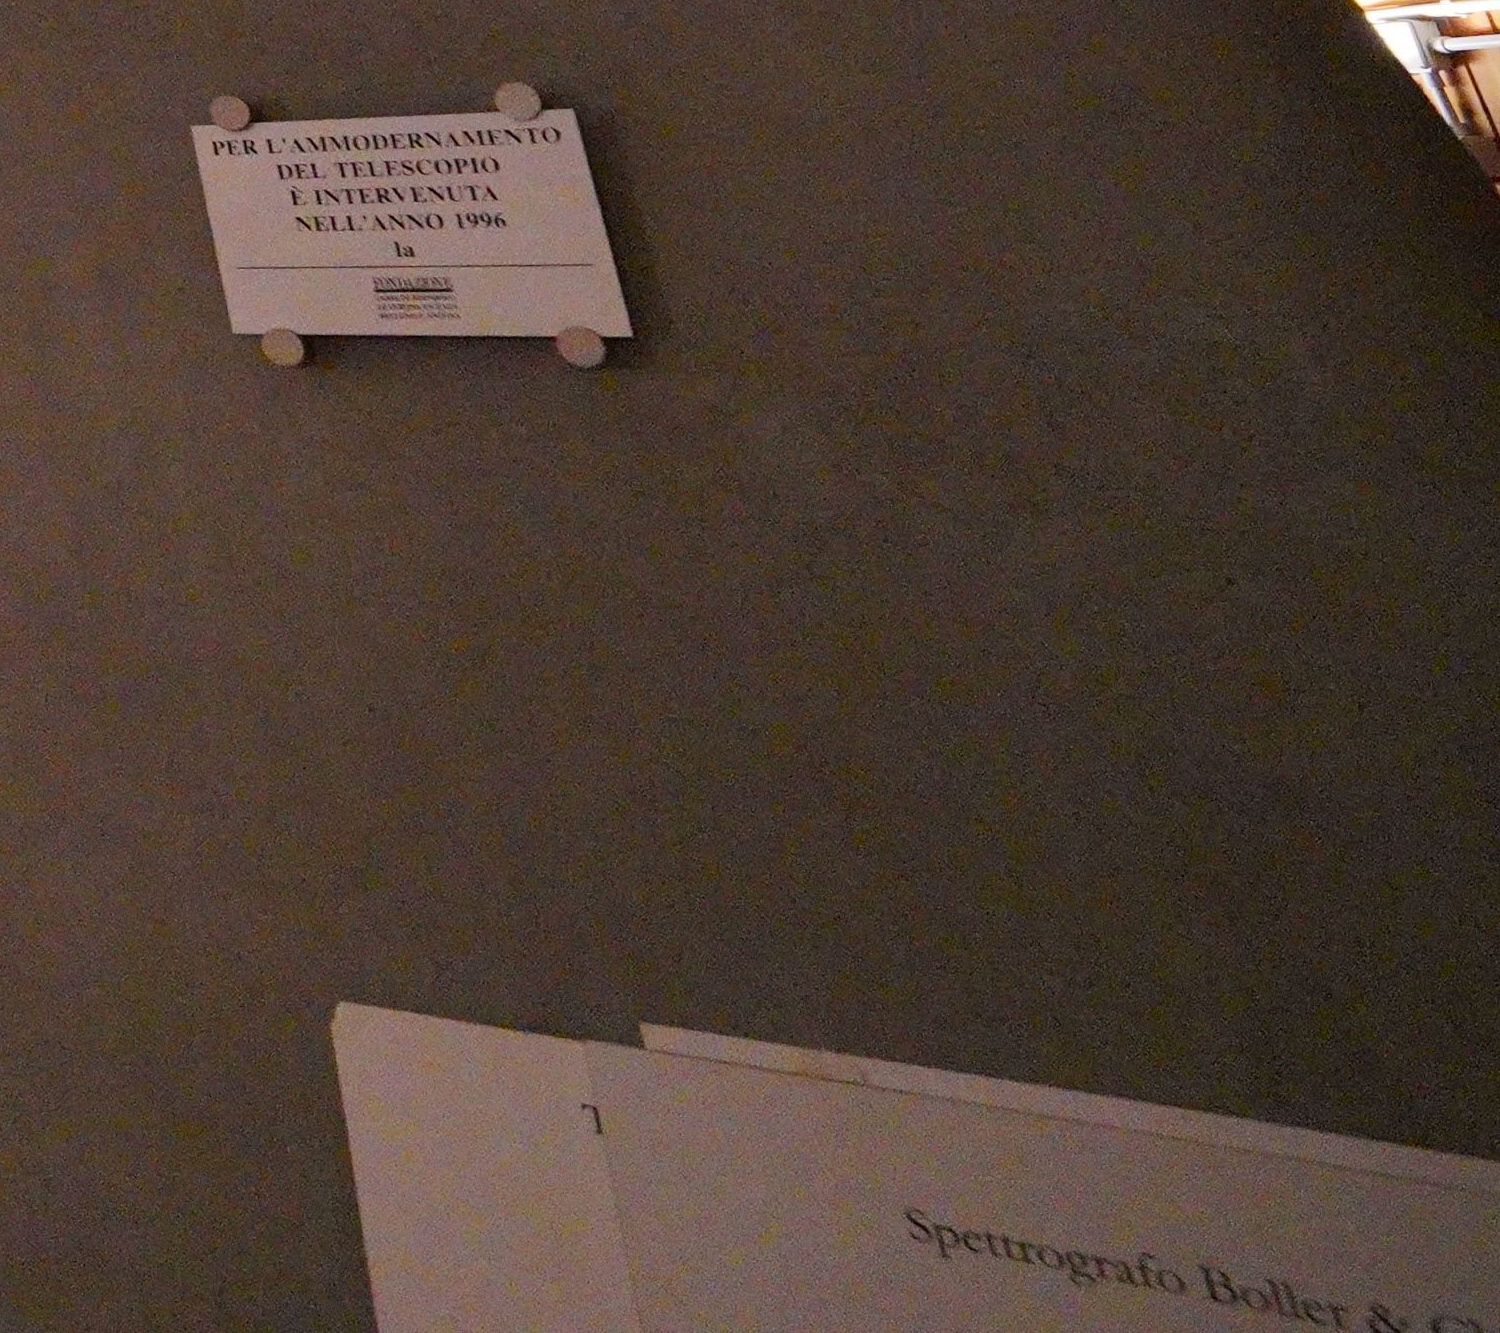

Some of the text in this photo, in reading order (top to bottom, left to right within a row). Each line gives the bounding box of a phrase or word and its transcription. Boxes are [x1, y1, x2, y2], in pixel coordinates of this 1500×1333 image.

[212, 125, 563, 157] PER L'AMMODERNAMENTO
[277, 155, 501, 181] DEL TELESCOPIO
[290, 184, 499, 207] È INTERVENUTA
[295, 211, 507, 233] NELL'ANNO 1996
[392, 240, 416, 259] la
[903, 1205, 1187, 1296] Spettrografo
[1200, 1264, 1347, 1325] Boller
